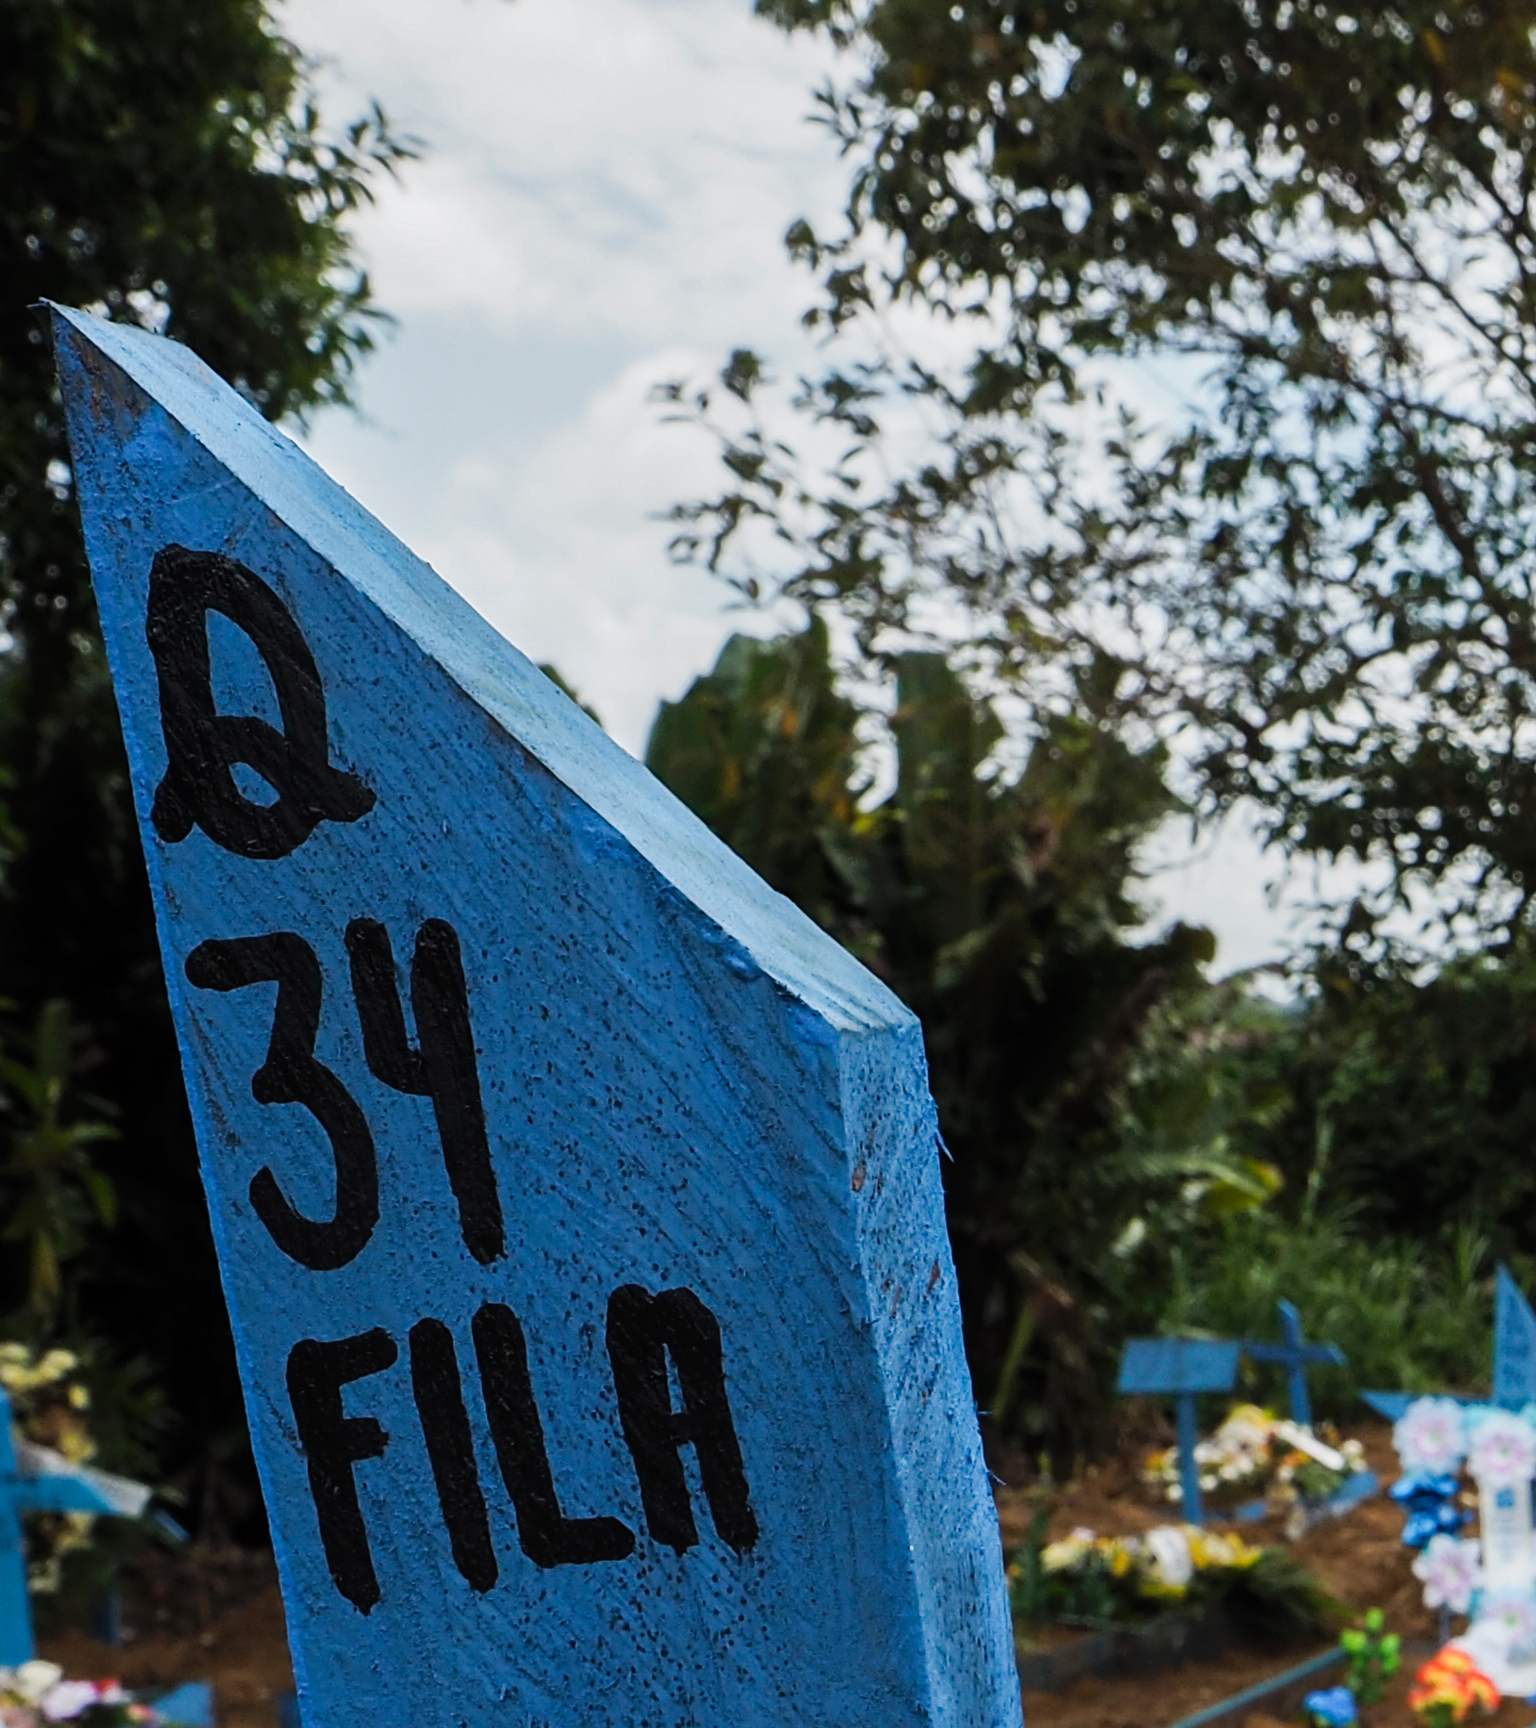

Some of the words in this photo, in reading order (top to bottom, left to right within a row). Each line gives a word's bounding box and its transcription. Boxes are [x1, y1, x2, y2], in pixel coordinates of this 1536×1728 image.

[146, 543, 377, 860] Q
[186, 917, 506, 1271] 34
[286, 1284, 763, 1616] FILA
